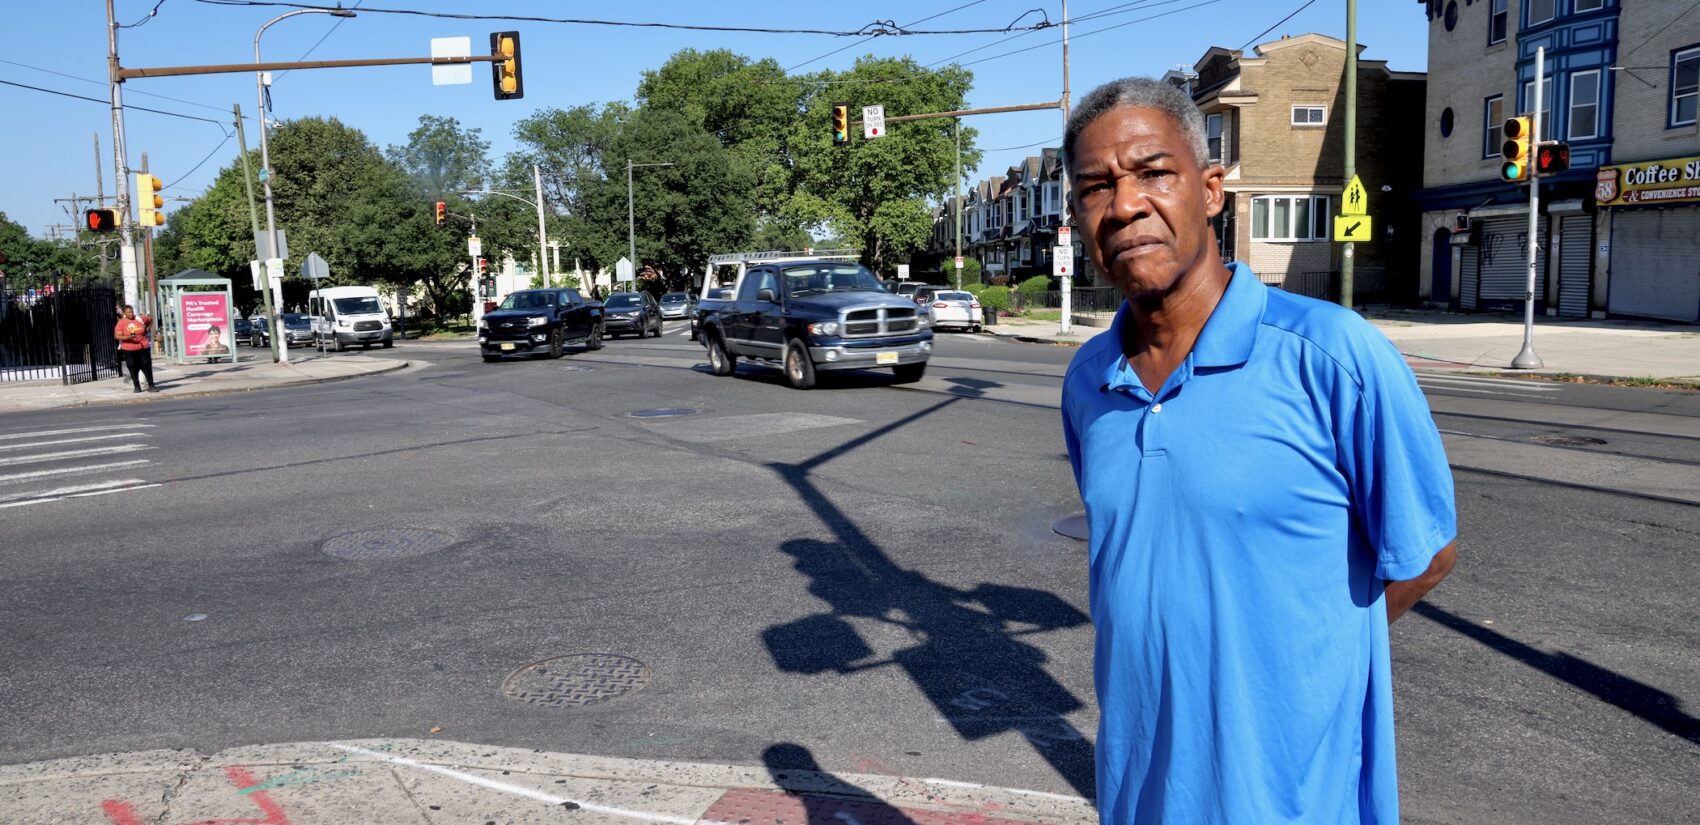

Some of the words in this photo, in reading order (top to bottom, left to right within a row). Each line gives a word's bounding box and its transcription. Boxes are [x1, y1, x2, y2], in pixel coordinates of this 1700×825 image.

[867, 107, 879, 115] NO
[1625, 165, 1678, 185] Coffee
[1598, 182, 1612, 199] 58
[1629, 190, 1640, 203] &
[1641, 188, 1686, 200] CONVENIENCE
